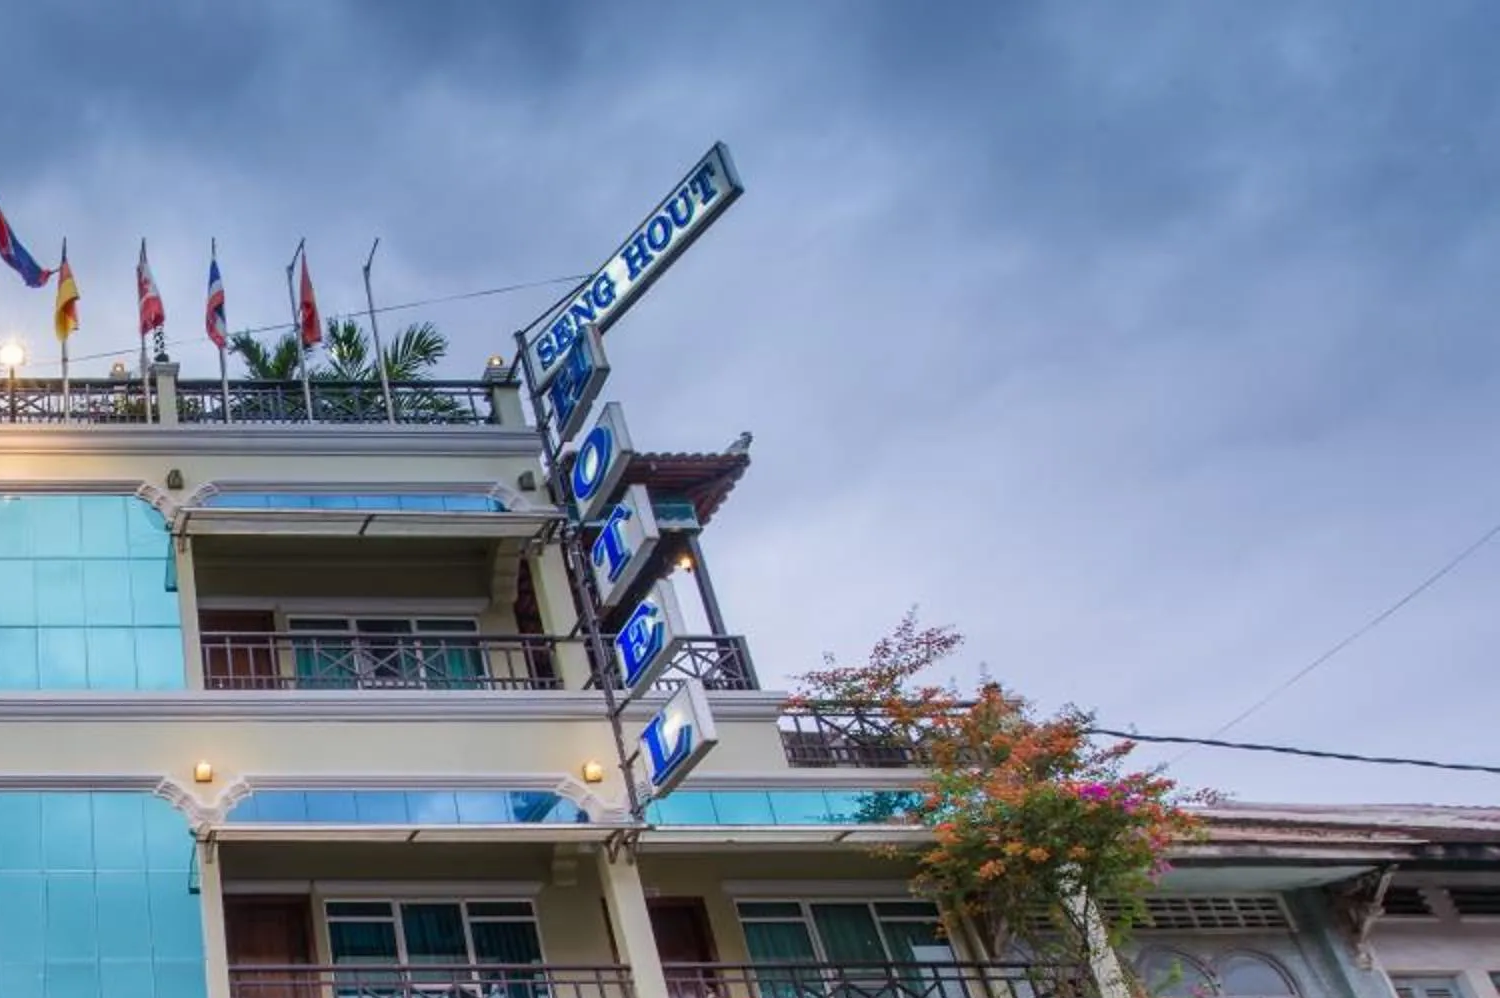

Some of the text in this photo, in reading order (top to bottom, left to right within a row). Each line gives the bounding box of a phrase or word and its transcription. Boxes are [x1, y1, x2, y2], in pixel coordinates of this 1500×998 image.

[537, 162, 717, 372] SENG HOUT
[548, 330, 695, 787] HOTEL
